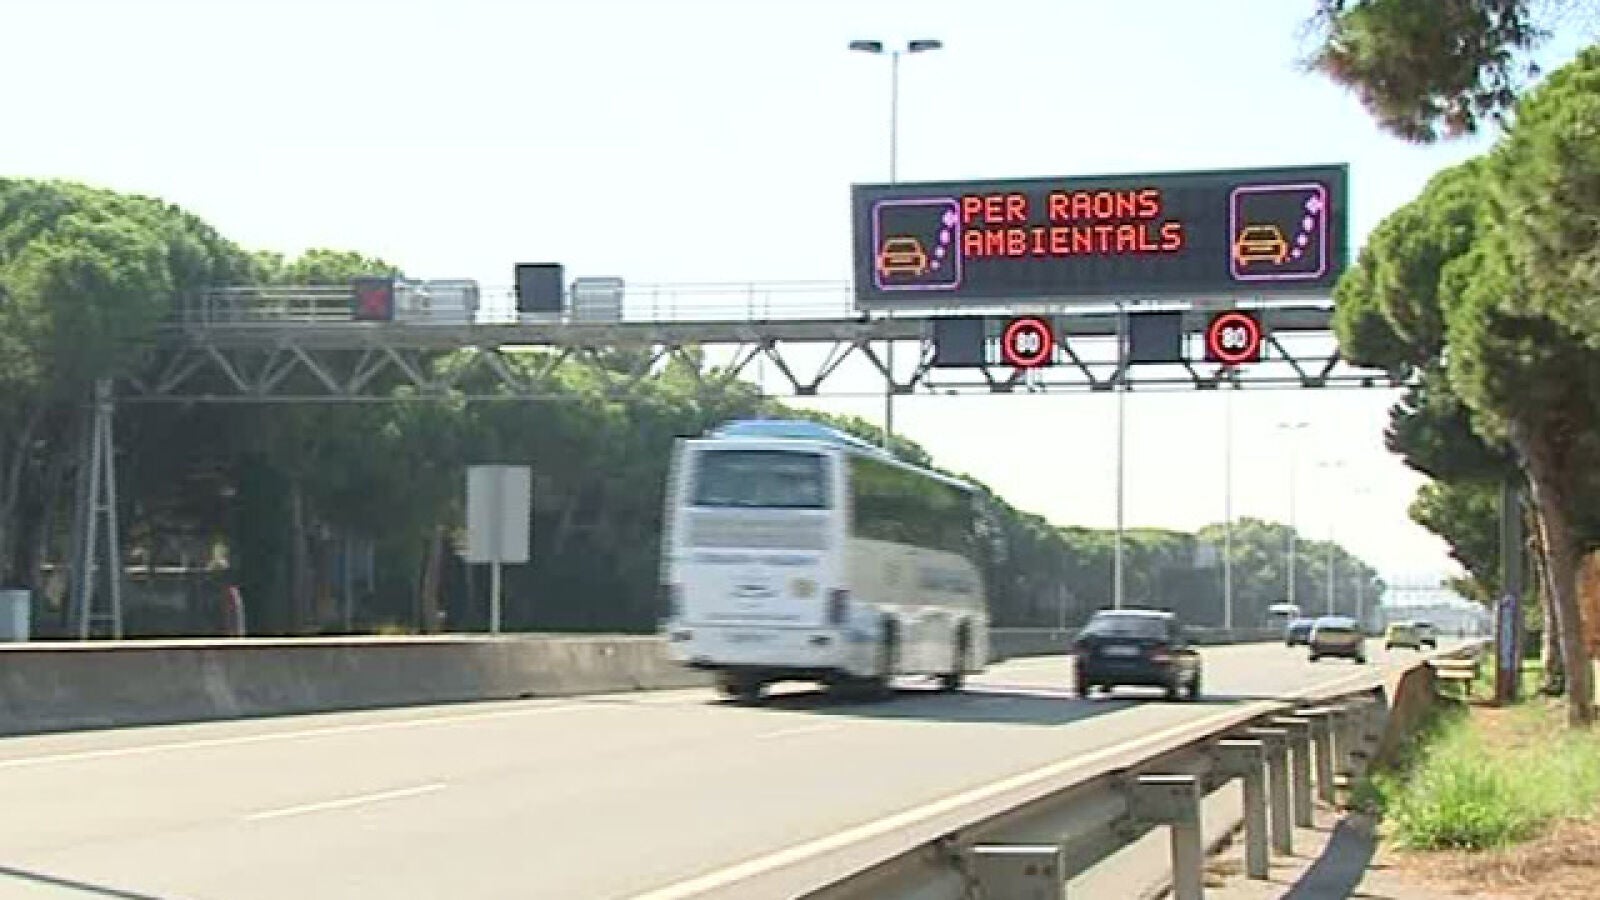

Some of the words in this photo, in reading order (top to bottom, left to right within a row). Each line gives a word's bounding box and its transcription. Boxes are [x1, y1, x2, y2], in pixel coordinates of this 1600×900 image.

[963, 195, 1027, 223] PER
[1050, 189, 1160, 220] RAONS
[964, 222, 1182, 256] AMBIENTALS
[1015, 331, 1041, 353] 80
[1221, 326, 1248, 348] 80
